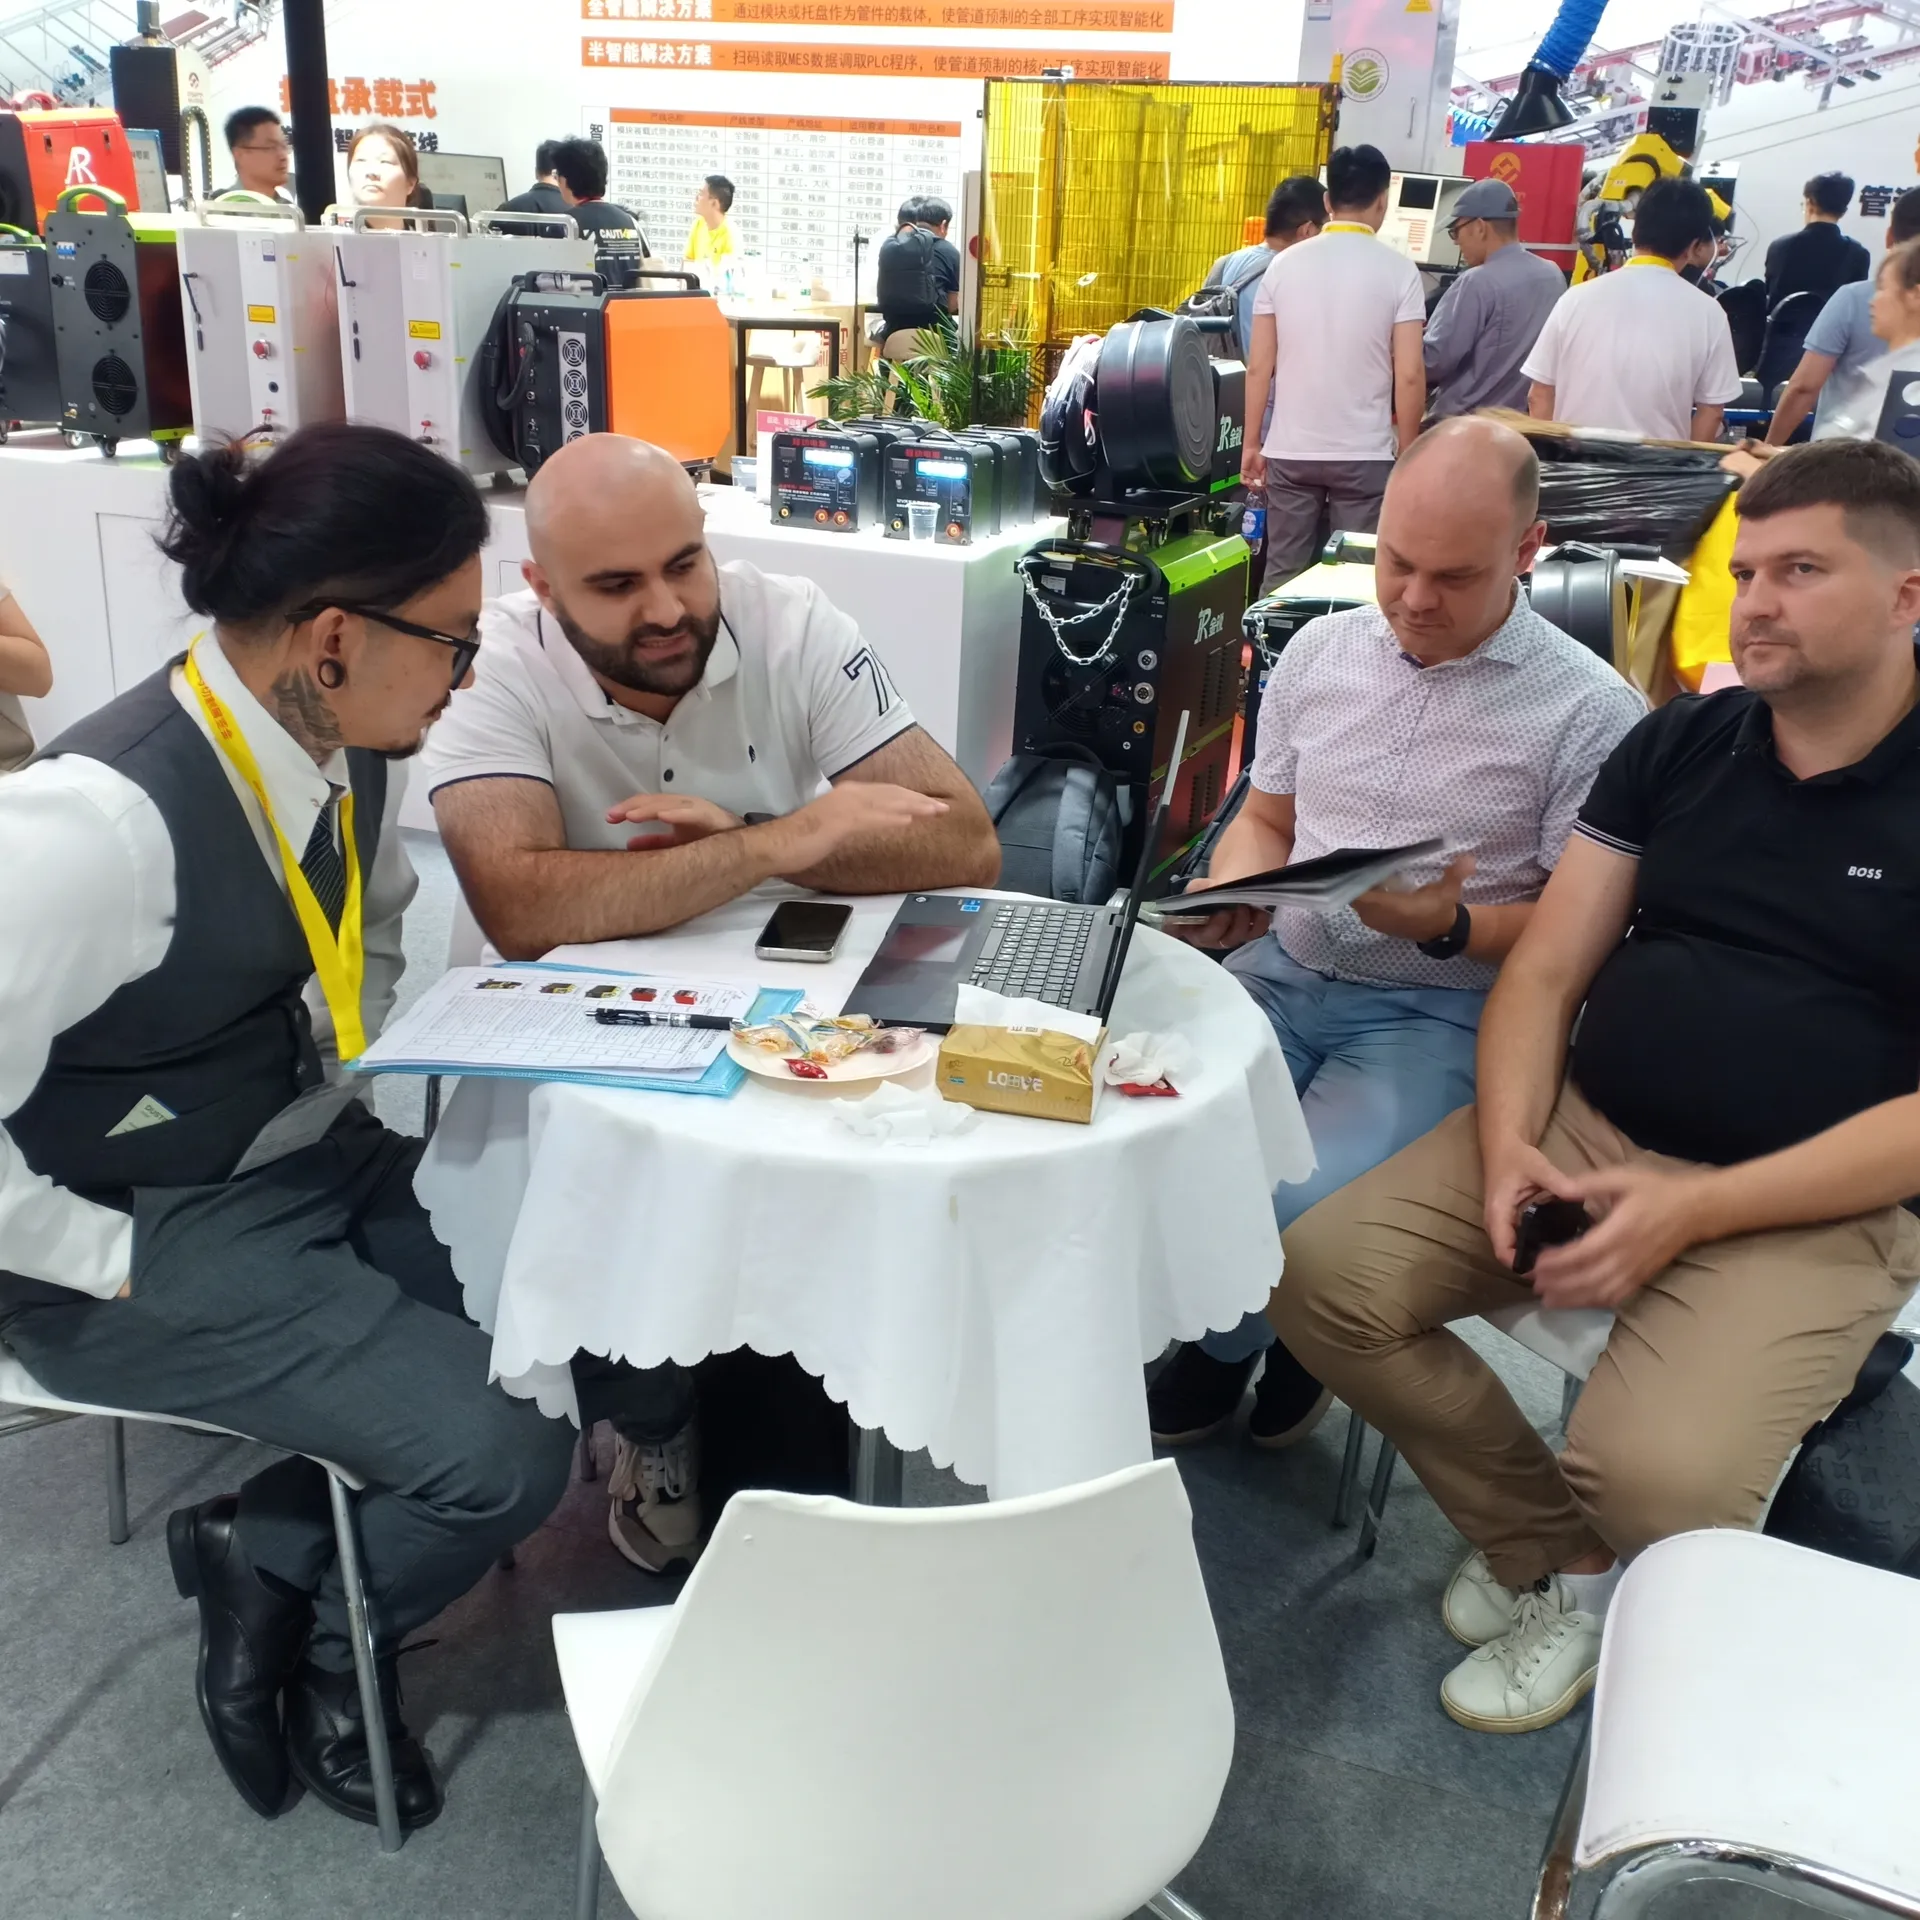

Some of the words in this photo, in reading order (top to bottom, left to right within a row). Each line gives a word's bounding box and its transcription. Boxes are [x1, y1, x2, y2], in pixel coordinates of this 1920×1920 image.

[588, 0, 712, 20] 全智能解决方案
[588, 41, 712, 66] 半智能解决方案
[1847, 865, 1883, 880] BOSS
